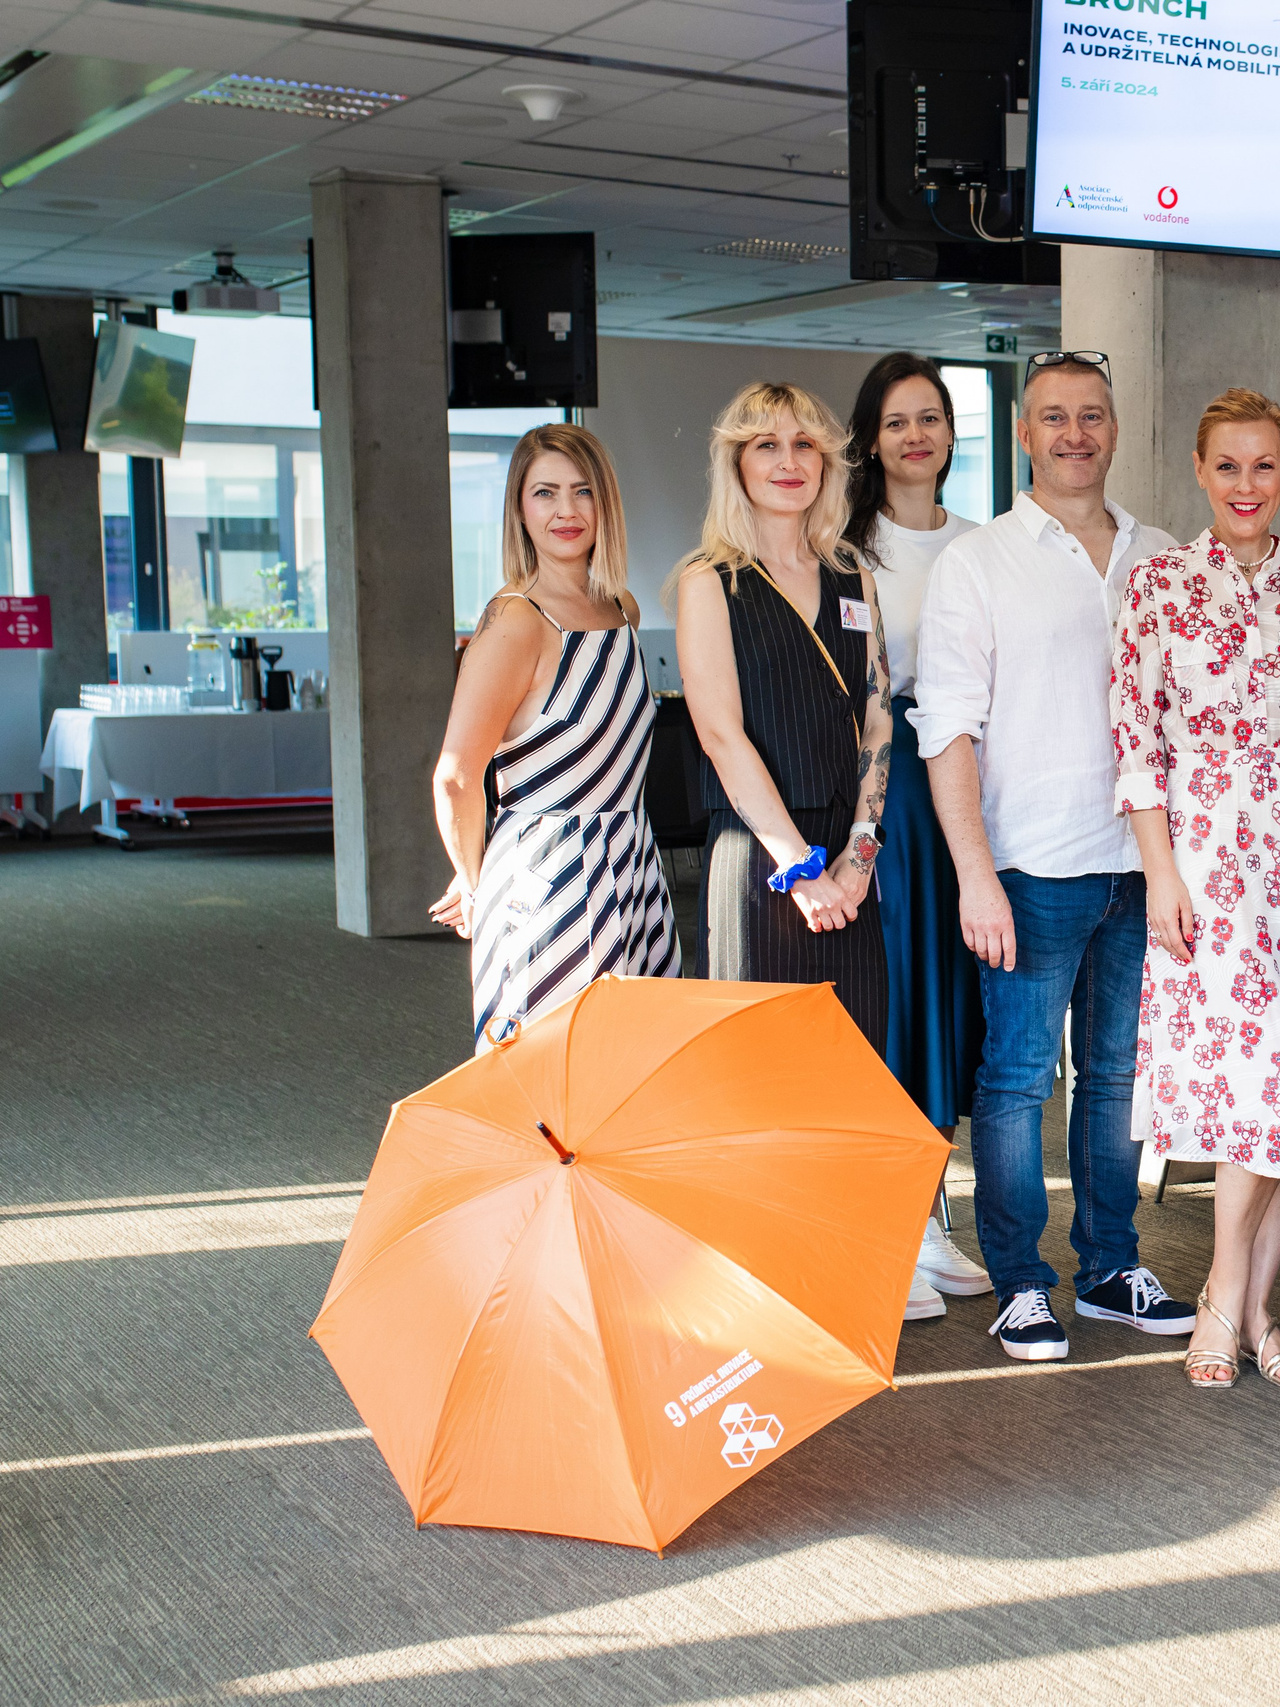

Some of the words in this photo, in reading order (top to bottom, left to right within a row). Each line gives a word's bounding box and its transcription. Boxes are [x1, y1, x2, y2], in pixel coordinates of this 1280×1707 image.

[1065, 0, 1207, 20] UNCH
[1063, 22, 1153, 46] INOVACE,
[1062, 42, 1076, 54] A
[1080, 43, 1203, 68] UDRŽITELNÁ
[1061, 77, 1076, 89] 5.
[1079, 79, 1111, 92] září
[1113, 82, 1159, 96] 2024
[1078, 184, 1112, 194] Asociace
[1143, 212, 1190, 225] vodafone
[716, 1348, 753, 1380] INOVACE
[664, 1401, 687, 1428] 9
